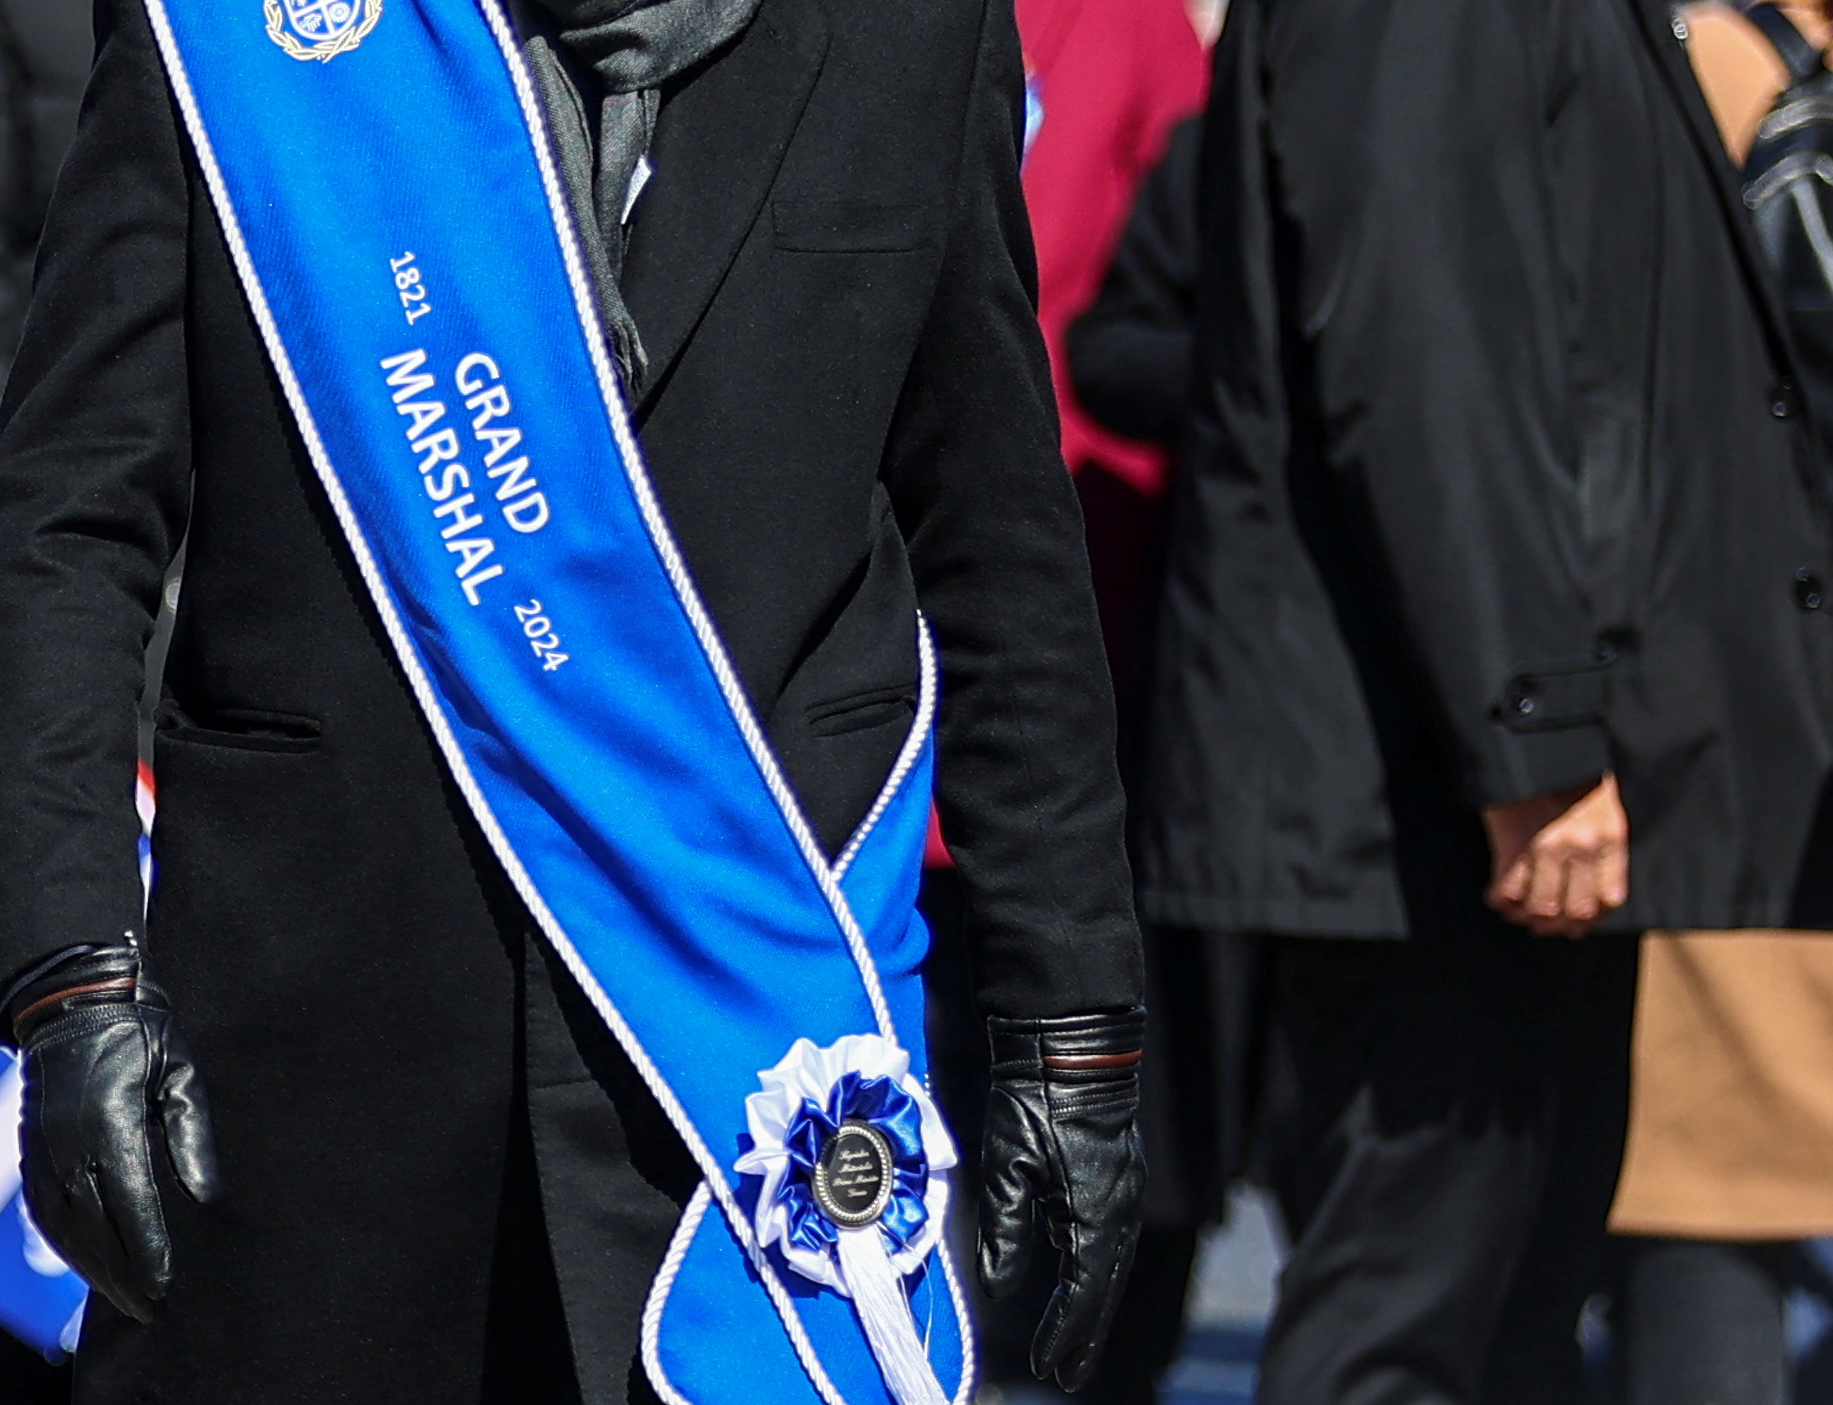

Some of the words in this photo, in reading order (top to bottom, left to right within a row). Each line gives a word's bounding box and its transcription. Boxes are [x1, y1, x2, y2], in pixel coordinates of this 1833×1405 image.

[388, 250, 433, 326] 1821
[379, 347, 505, 607] MARSHAL
[454, 351, 551, 535] GRAND
[512, 597, 570, 672] 2024
